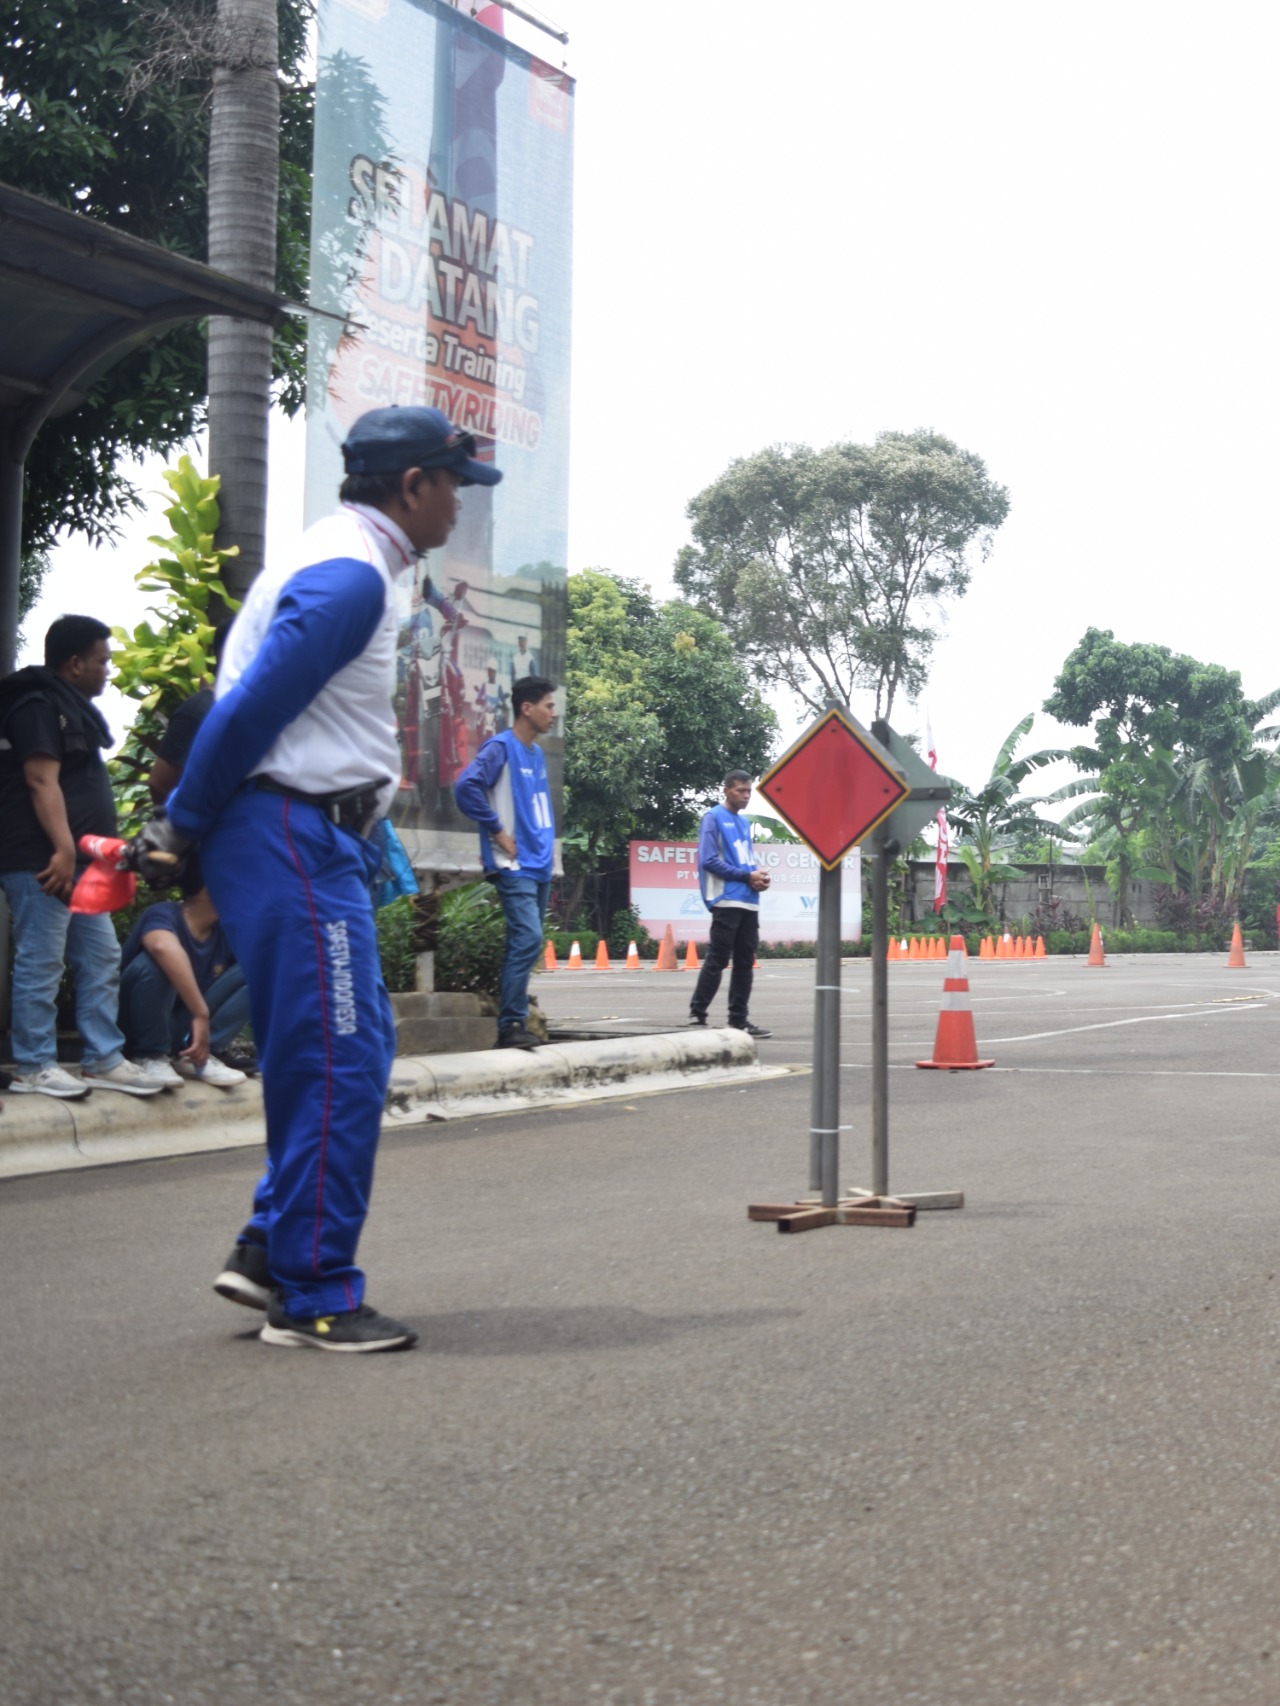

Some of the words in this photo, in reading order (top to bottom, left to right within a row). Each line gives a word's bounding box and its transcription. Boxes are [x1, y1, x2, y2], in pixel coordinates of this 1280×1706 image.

[349, 154, 534, 290] SELAMAT
[378, 237, 540, 353] DATANG
[441, 330, 526, 400] Training
[637, 845, 699, 864] SAFET
[786, 852, 855, 870] CENR
[676, 870, 690, 880] PT
